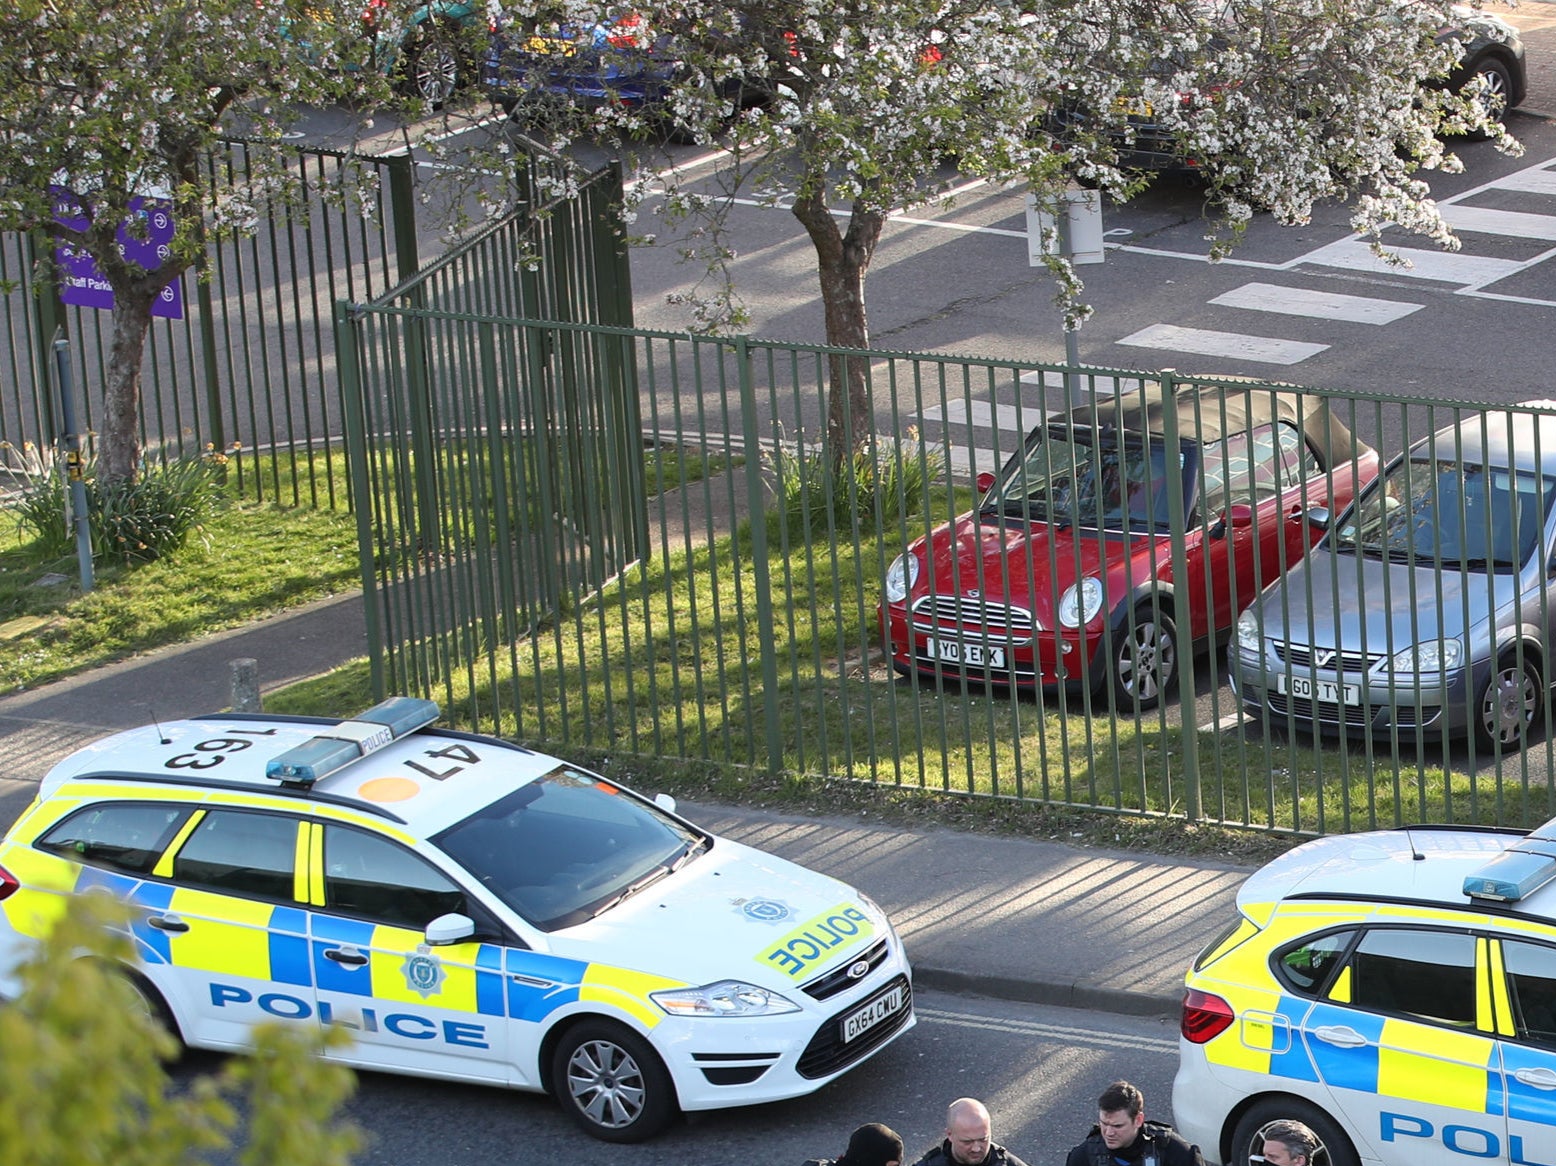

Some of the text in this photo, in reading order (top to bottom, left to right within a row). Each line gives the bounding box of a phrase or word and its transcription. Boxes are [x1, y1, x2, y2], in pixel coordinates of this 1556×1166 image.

[88, 278, 113, 291] Parki
[164, 728, 279, 770] 163
[361, 728, 393, 751] POLICE
[403, 743, 482, 781] 47
[209, 982, 490, 1050] POLICE
[848, 991, 898, 1037] GX64 CWU
